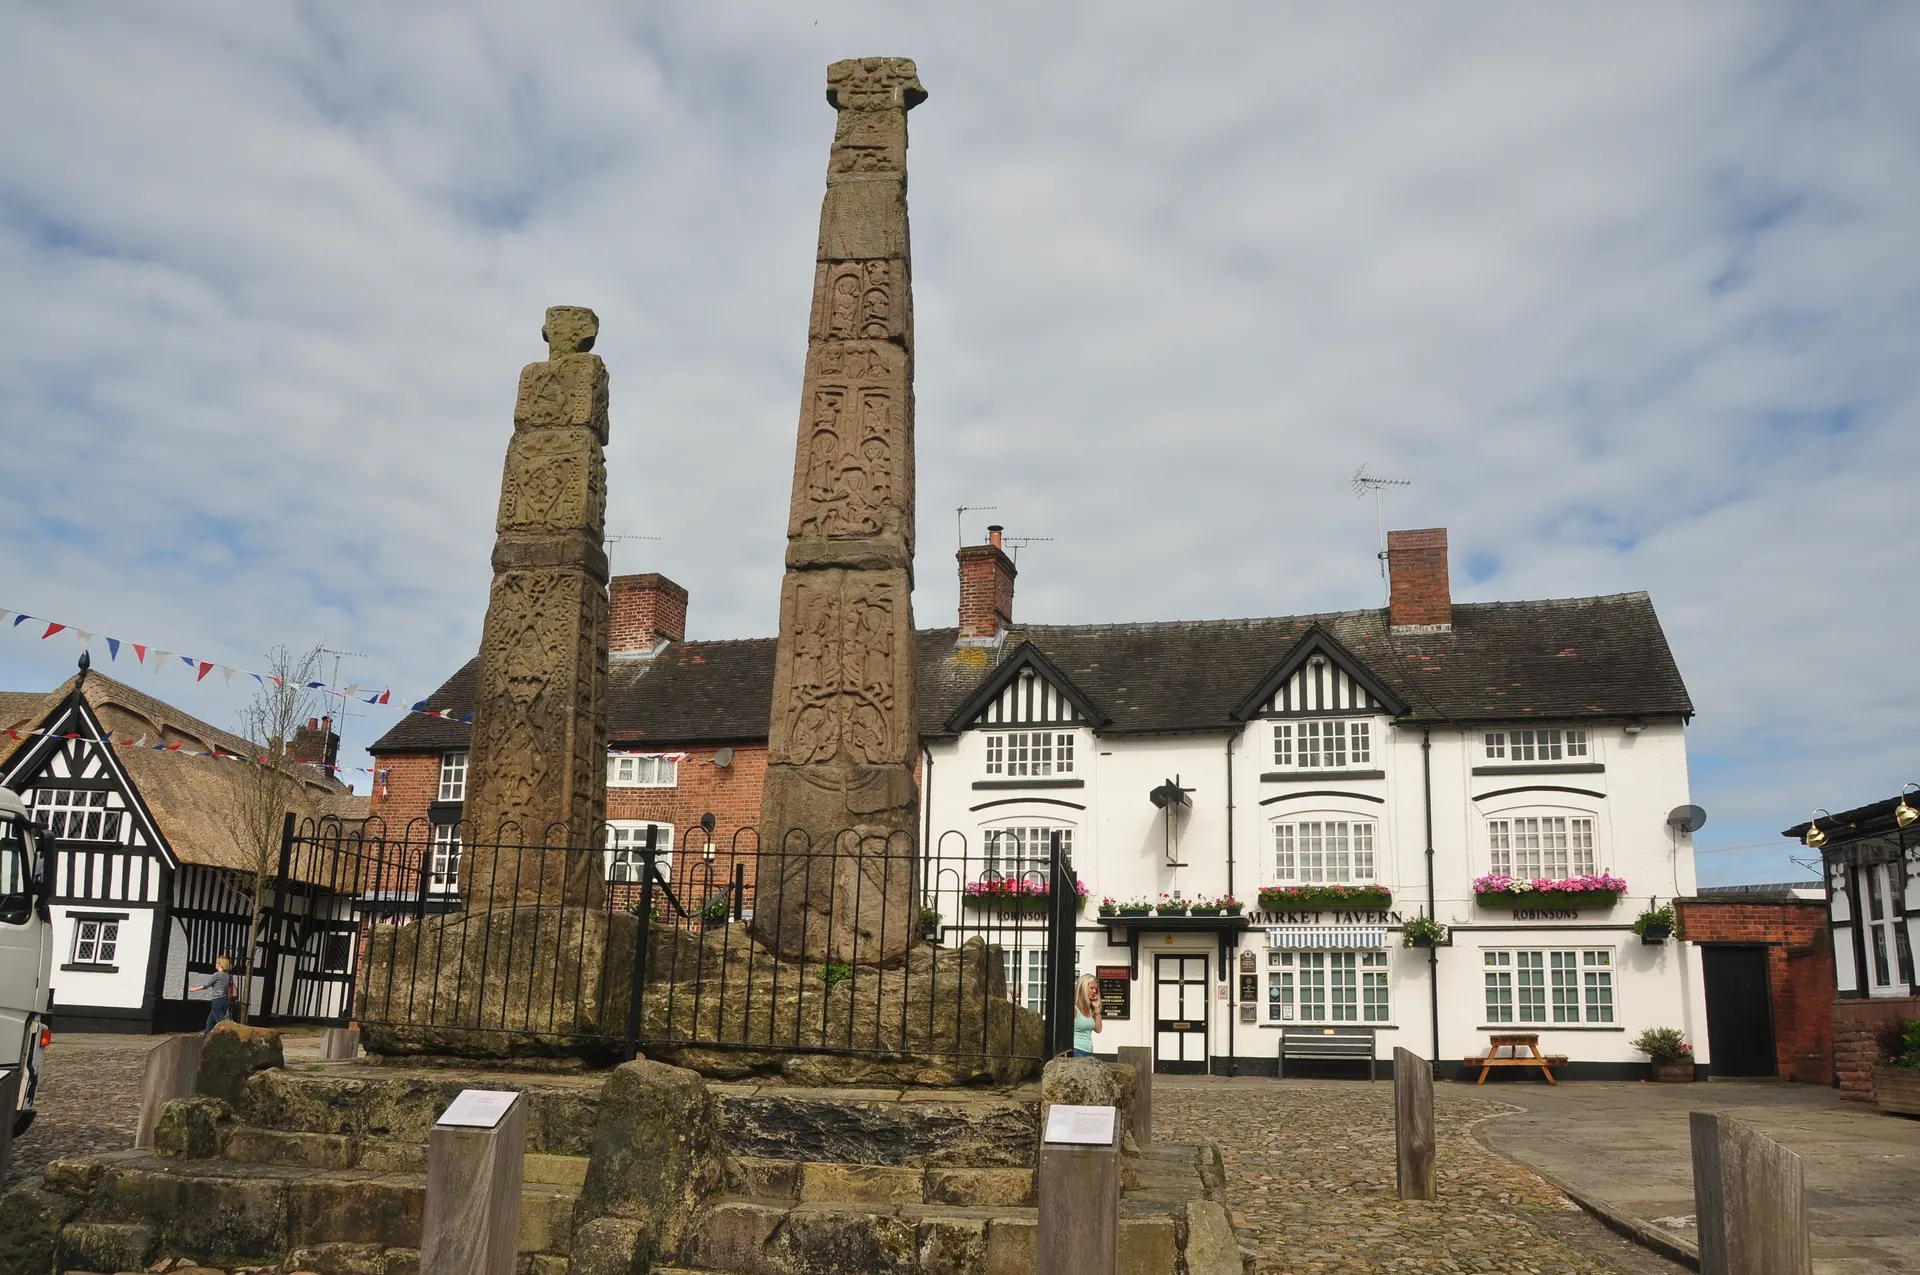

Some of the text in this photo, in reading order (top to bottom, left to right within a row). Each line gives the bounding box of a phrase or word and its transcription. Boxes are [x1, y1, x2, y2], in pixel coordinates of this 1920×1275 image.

[1248, 910, 1403, 925] MARKET TAVERN
[1513, 908, 1578, 920] ROBINSONS
